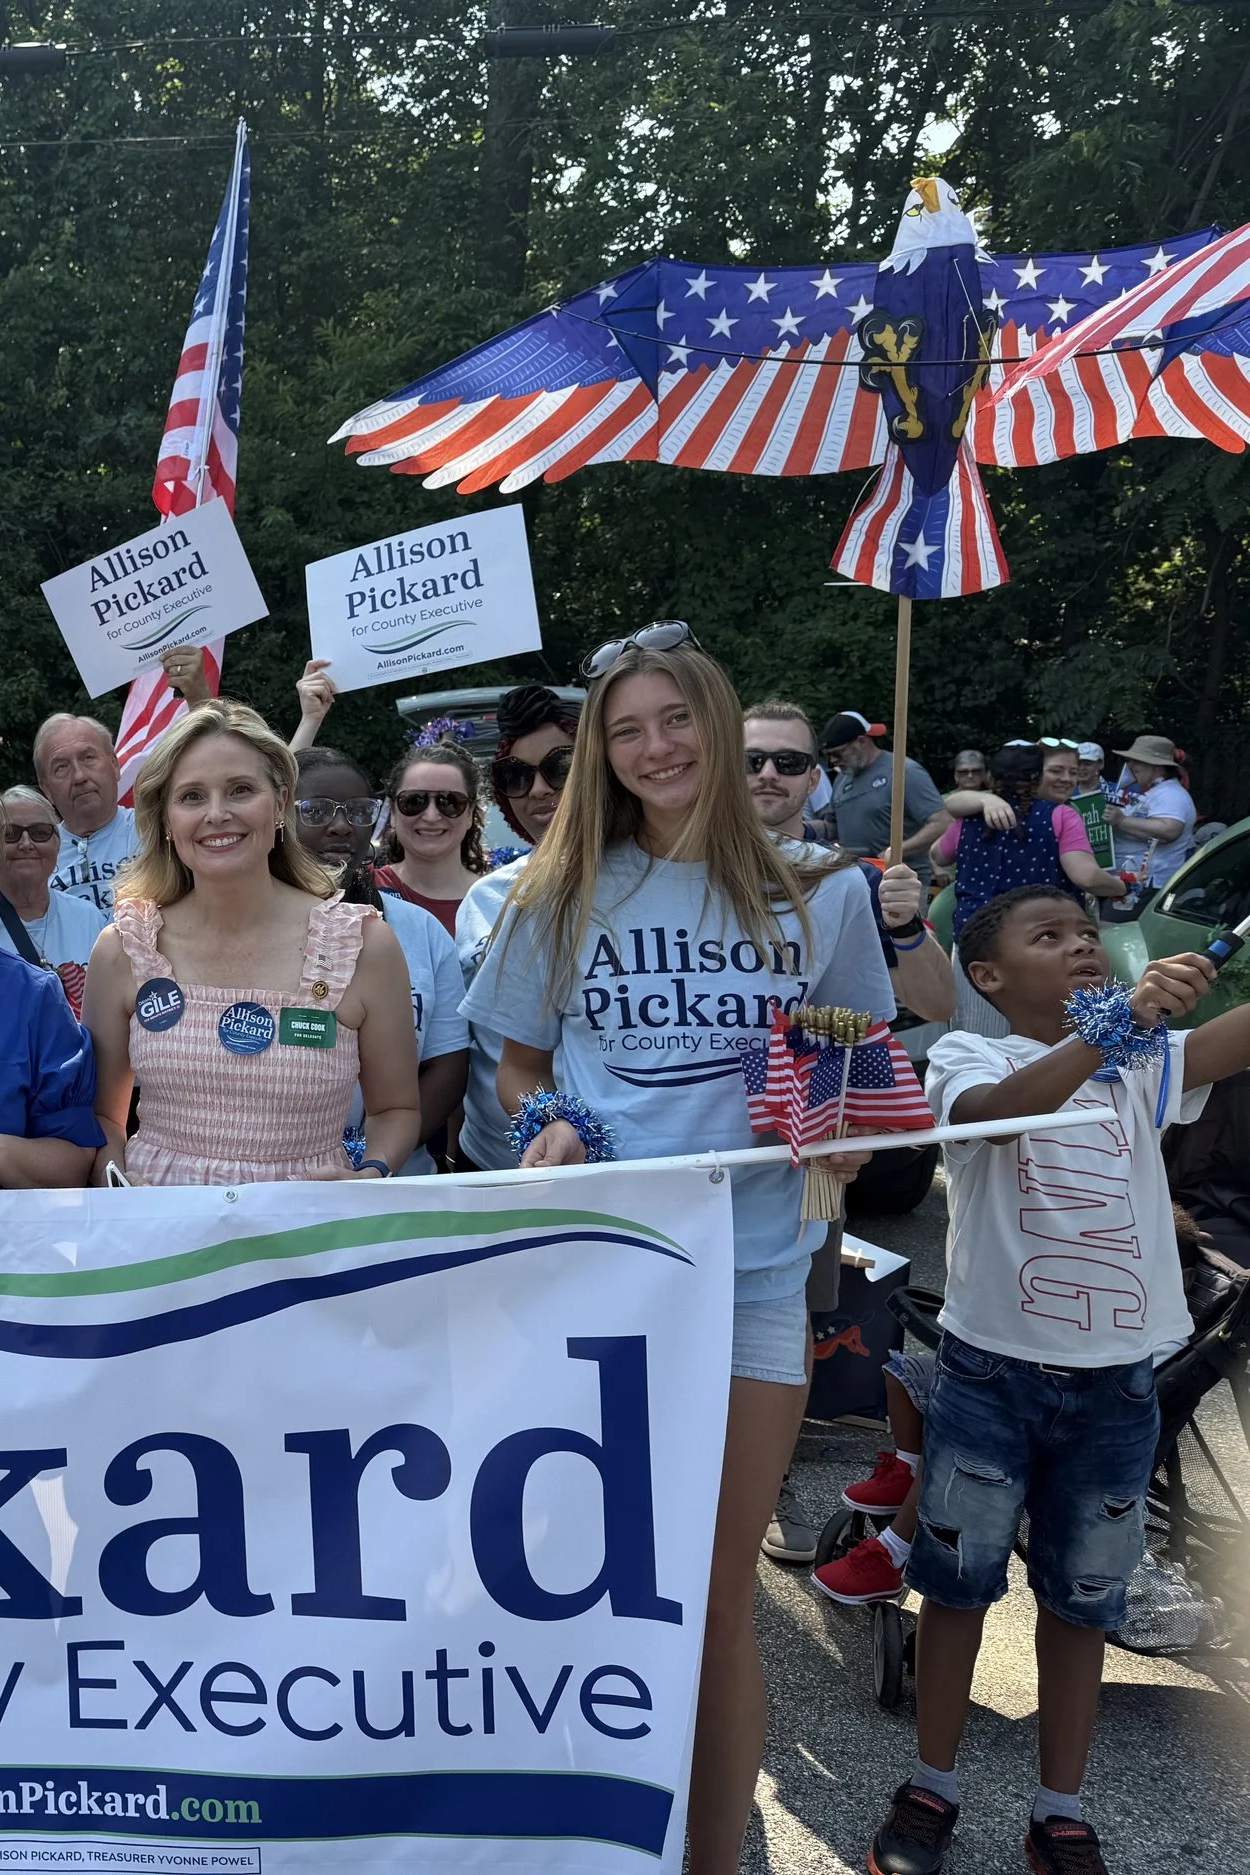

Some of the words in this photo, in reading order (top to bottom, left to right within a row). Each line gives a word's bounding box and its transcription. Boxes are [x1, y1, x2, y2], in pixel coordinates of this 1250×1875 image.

[90, 529, 191, 593] Allison
[350, 531, 472, 582] Allison
[90, 551, 209, 626] Pickard
[345, 558, 484, 619] Pickard
[107, 628, 123, 640] for
[124, 609, 161, 632] County
[163, 583, 213, 614] Executive
[352, 624, 368, 636] for
[371, 613, 417, 632] County
[420, 598, 483, 620] Executive
[138, 625, 207, 663] AllisonPickard.com
[377, 643, 464, 669] AllisonPickard.com
[1088, 824, 1108, 842] ETH
[584, 927, 803, 980] Allison
[141, 990, 181, 1017] GILE
[226, 1007, 273, 1027] Allison
[220, 1017, 273, 1039] Pickard
[291, 1021, 310, 1030] CHUCK
[311, 1023, 326, 1032] COOK
[622, 1032, 702, 1052] County
[710, 1033, 769, 1051] Execu
[67, 1641, 652, 1741] Executive
[31, 1851, 85, 1862] PICKARD,
[88, 1851, 155, 1864] TREASURER
[158, 1856, 208, 1866] YVONNE
[211, 1856, 253, 1866] POWEL
